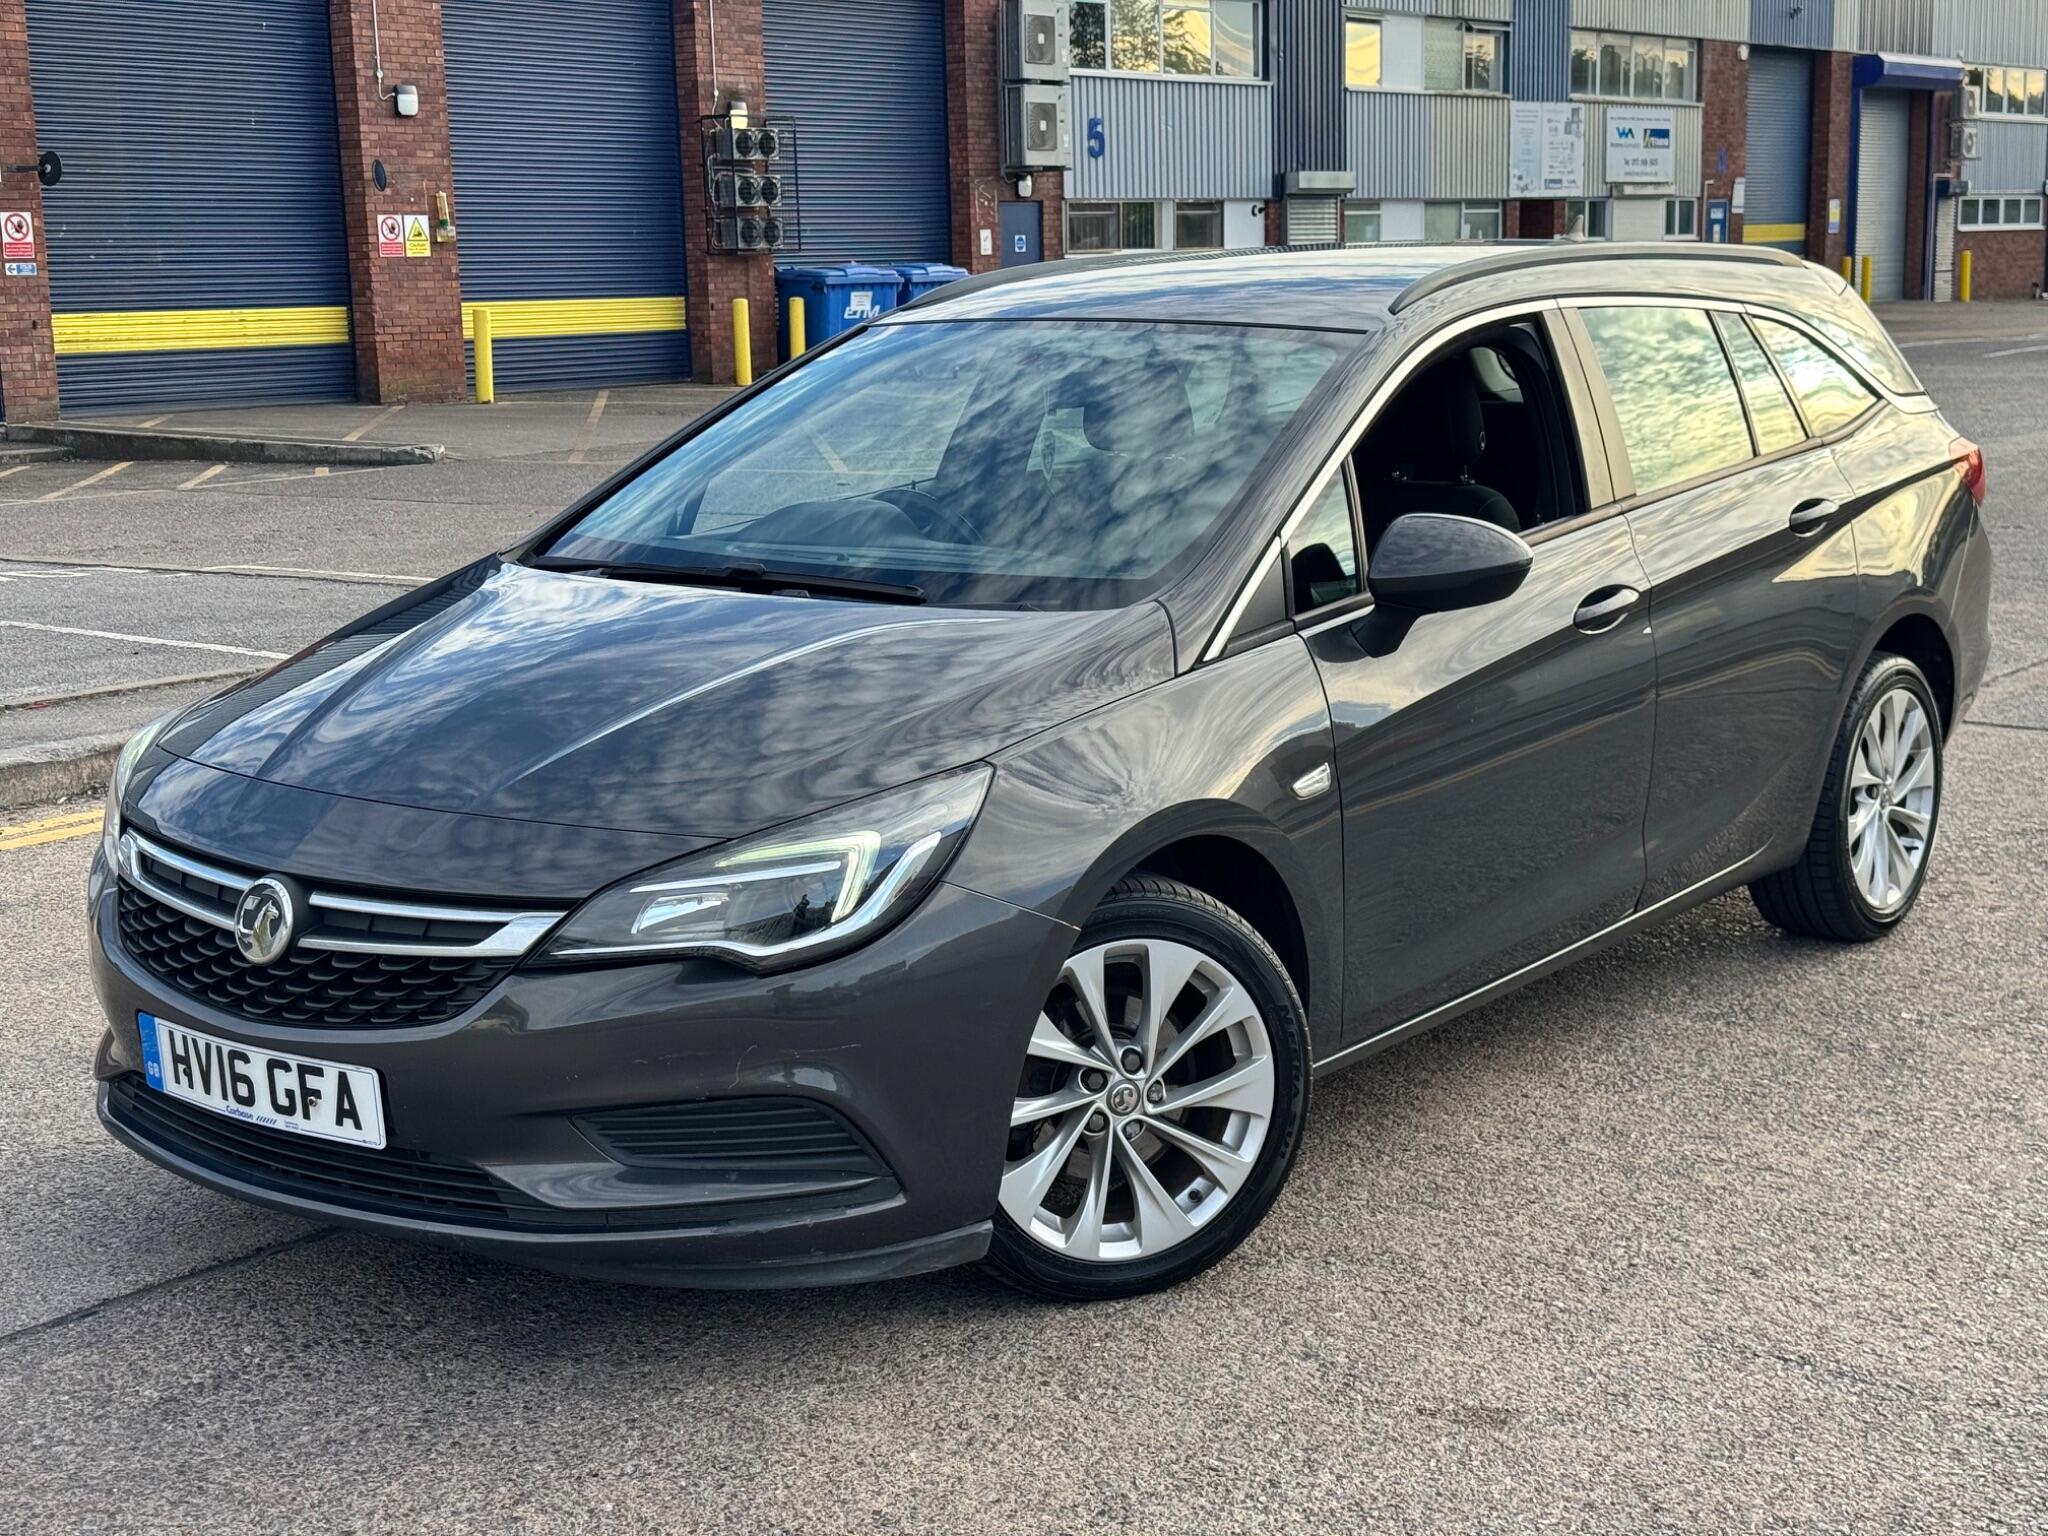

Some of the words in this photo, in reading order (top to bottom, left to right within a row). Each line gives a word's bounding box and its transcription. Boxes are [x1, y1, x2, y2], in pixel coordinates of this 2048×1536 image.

[1087, 117, 1105, 159] 5
[147, 1061, 160, 1078] GB
[168, 1029, 256, 1108] HV16
[266, 1057, 363, 1131] GFA
